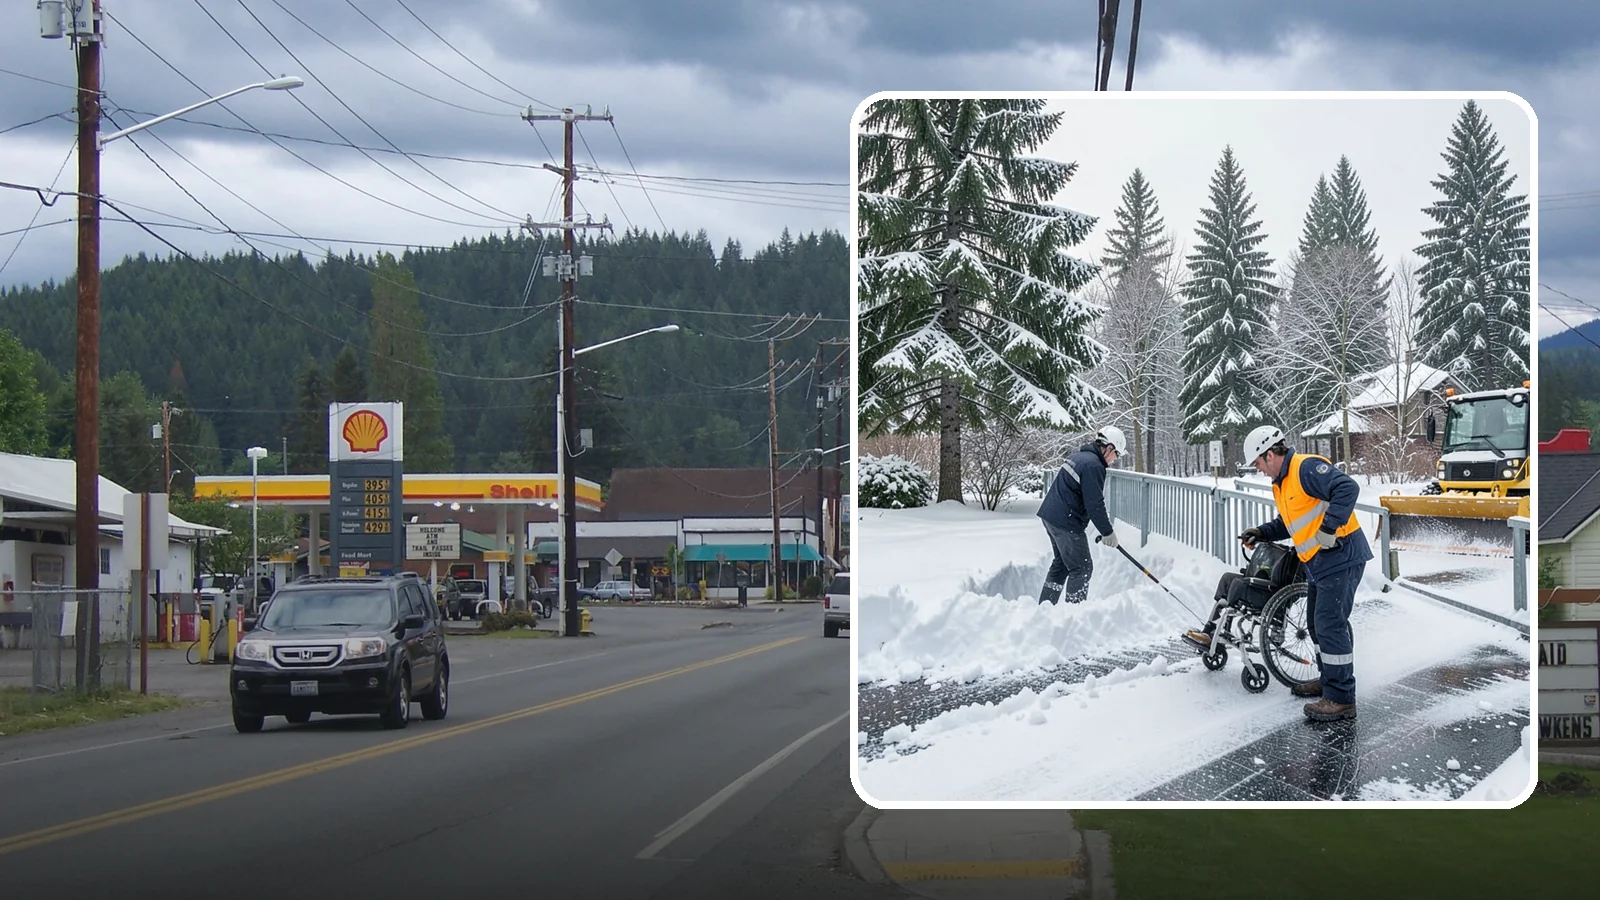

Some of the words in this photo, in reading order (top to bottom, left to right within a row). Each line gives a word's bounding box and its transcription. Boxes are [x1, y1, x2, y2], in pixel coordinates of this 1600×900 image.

[365, 480, 384, 490] 395
[490, 484, 547, 499] Shell
[365, 494, 384, 504] 405
[365, 508, 383, 518] 415
[365, 522, 384, 533] 429
[1538, 642, 1566, 666] AID
